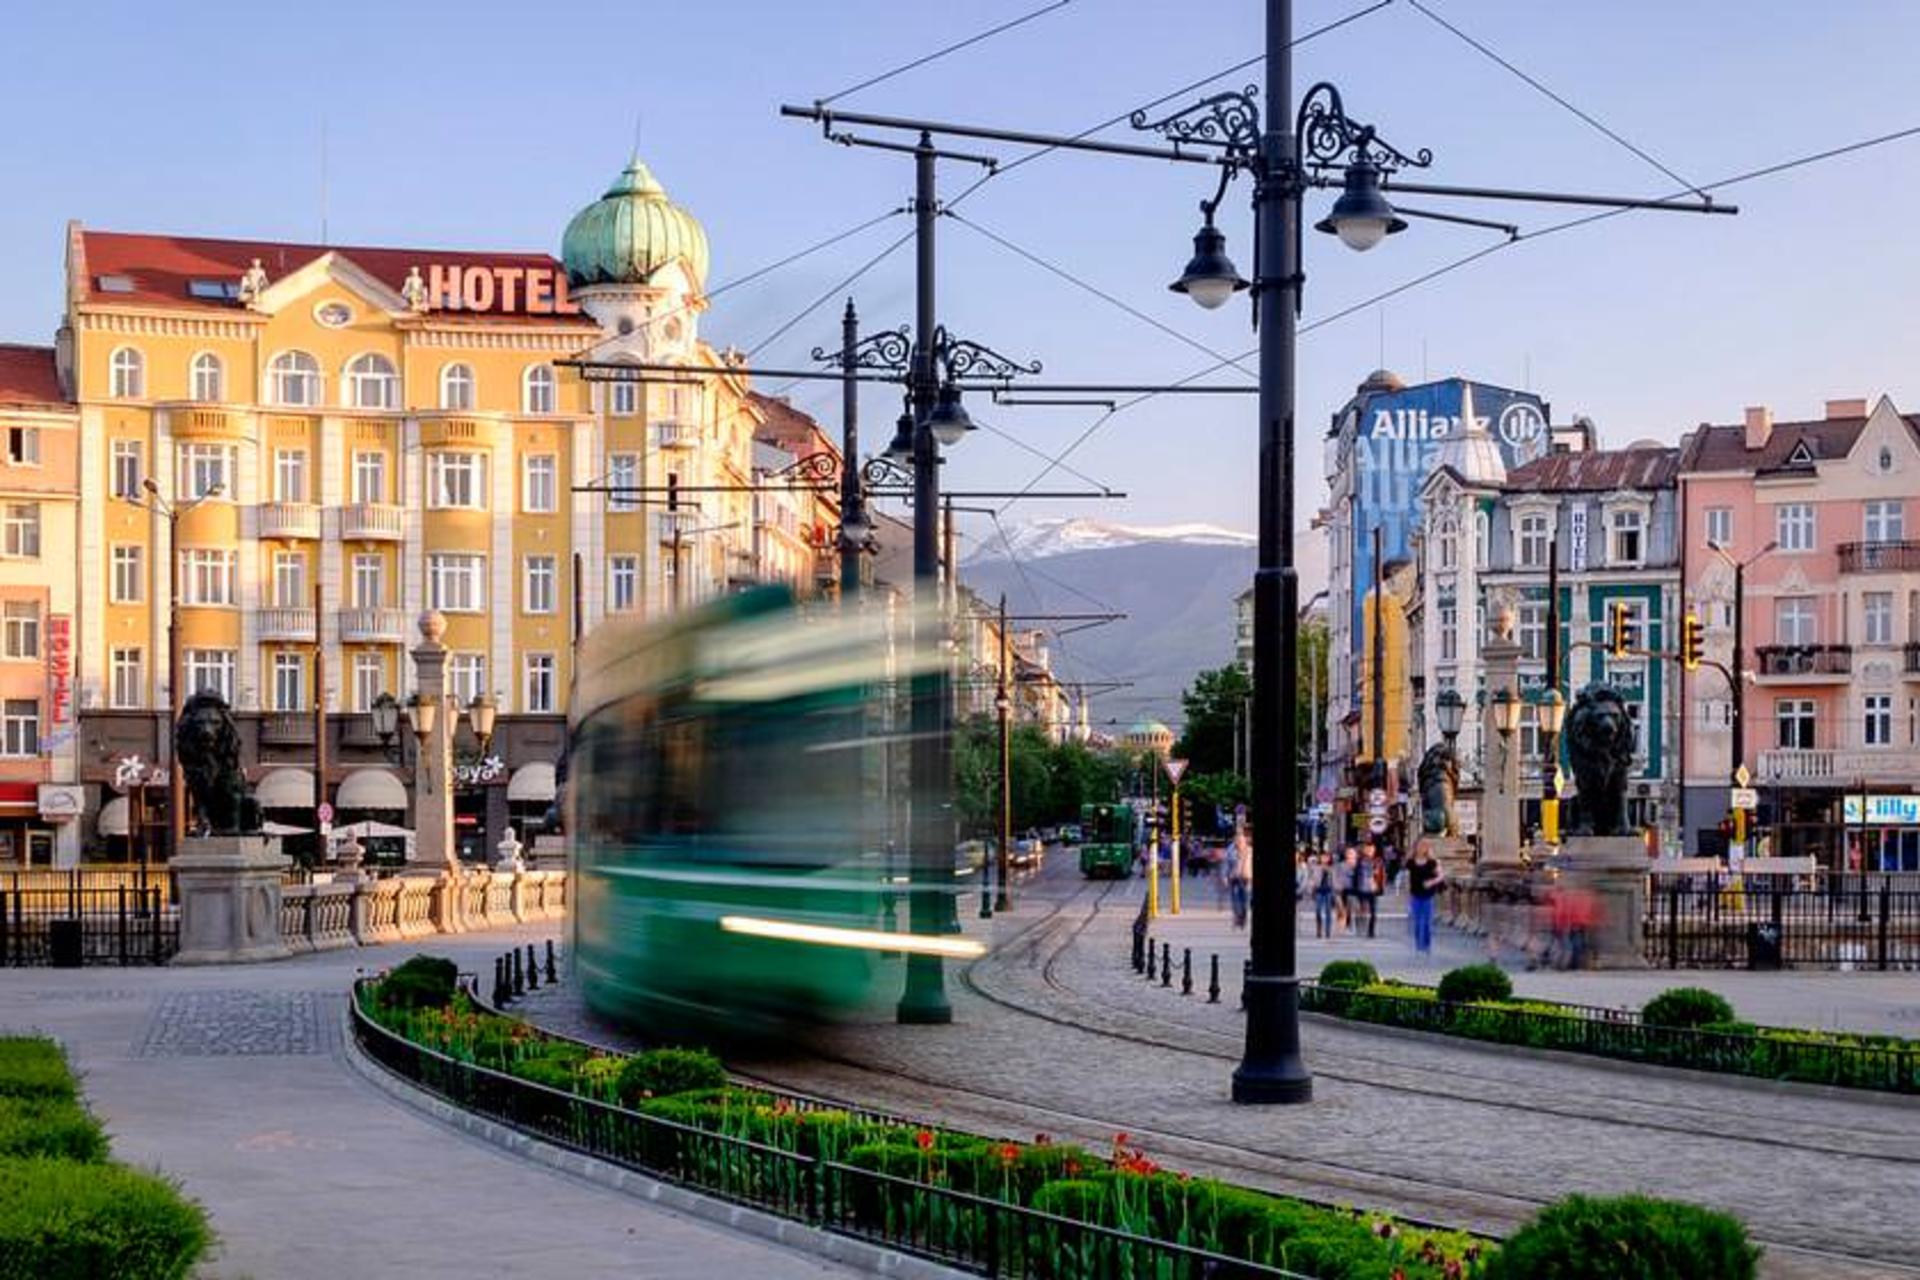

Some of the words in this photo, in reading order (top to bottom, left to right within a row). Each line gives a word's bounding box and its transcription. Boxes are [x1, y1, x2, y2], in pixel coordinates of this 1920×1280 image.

[430, 265, 581, 314] HOTEL
[51, 619, 70, 724] HOSTEL
[1876, 798, 1917, 821] lilly
